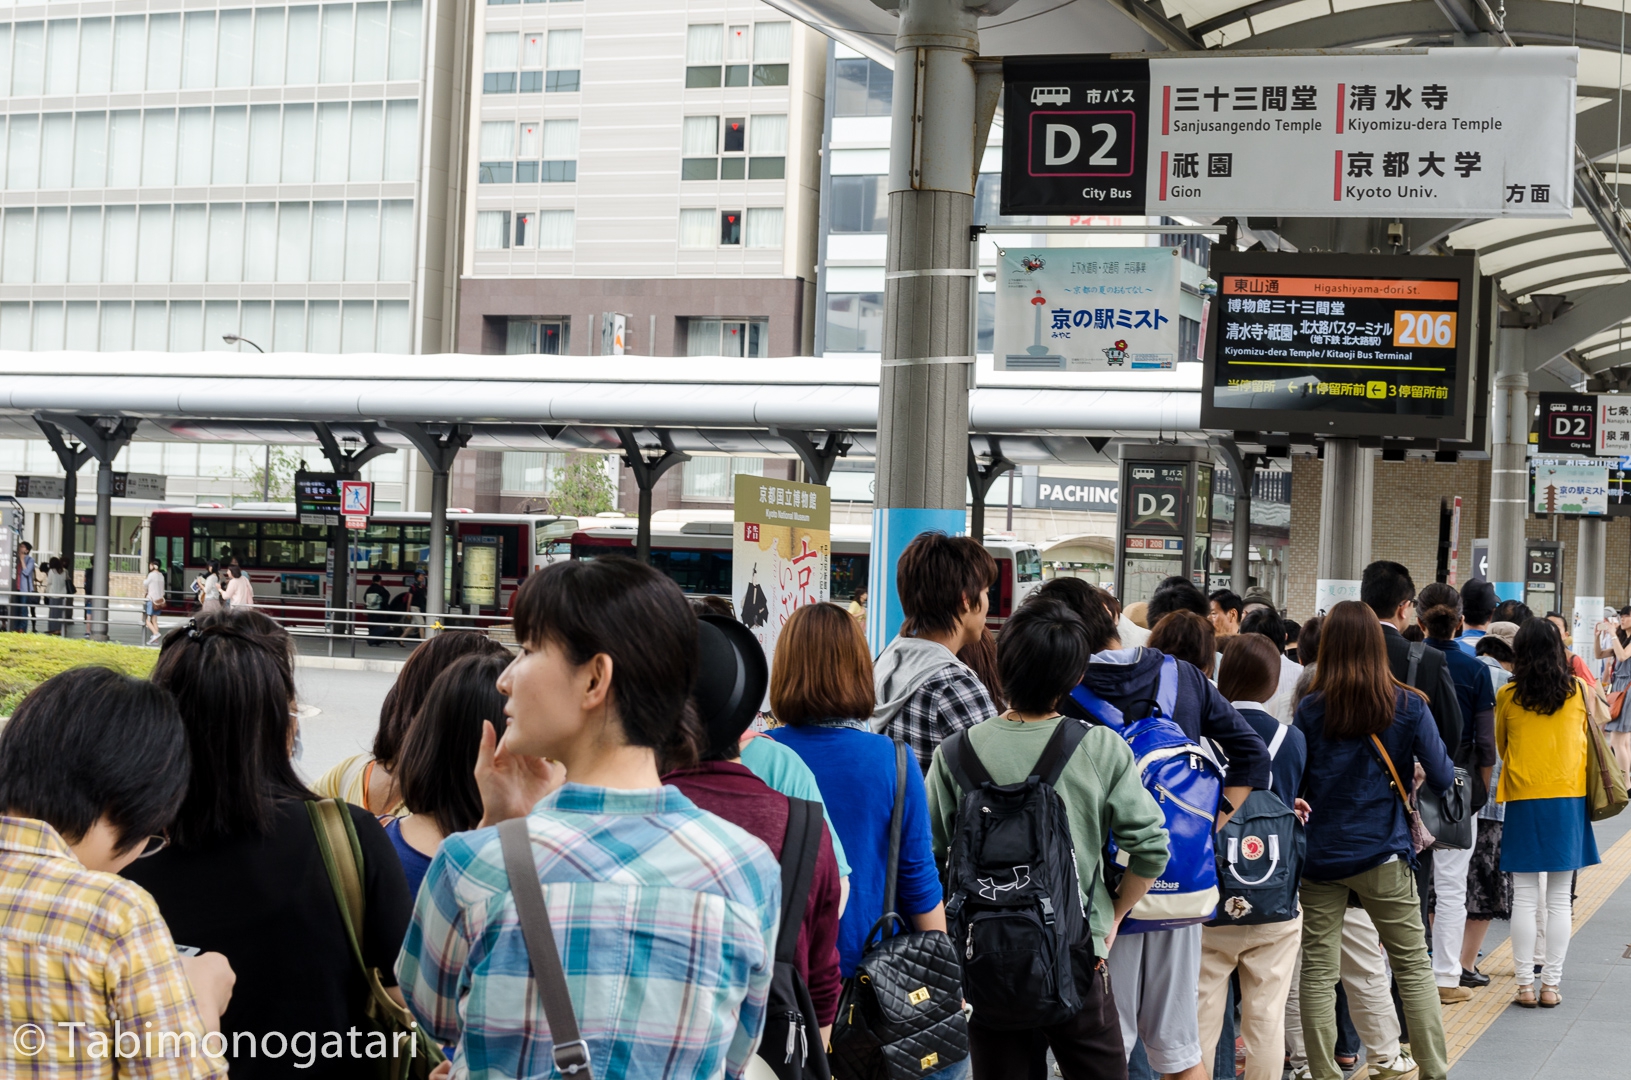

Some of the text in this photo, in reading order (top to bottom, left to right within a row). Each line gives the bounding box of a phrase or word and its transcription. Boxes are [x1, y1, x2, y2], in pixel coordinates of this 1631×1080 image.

[1086, 88, 1136, 104] 市バス
[1174, 85, 1318, 112] 三十三間堂
[1349, 83, 1449, 111] 清水寺
[1173, 118, 1322, 135] Sanjusangendo Temple
[1348, 117, 1502, 133] Kiyomizu-dera Temple
[1044, 123, 1118, 166] D2
[1172, 152, 1233, 178] 祇園
[1346, 151, 1482, 178] 京都大学
[1082, 187, 1132, 200] City Bus
[1171, 185, 1202, 198] Gion
[1346, 185, 1438, 201] Kyoto Univ.
[1506, 184, 1551, 203] 方面
[1233, 279, 1280, 294] 東山通
[1314, 283, 1420, 295] Higashiyama-dori St.
[1227, 298, 1345, 315] 博物館三十三間堂
[1051, 308, 1169, 330] 京の駅ミスト
[1051, 331, 1072, 339] みやこ
[1398, 312, 1452, 345] 206
[1225, 347, 1288, 357] Kiyomizu-dera
[1289, 348, 1320, 358] Temple
[1326, 350, 1356, 360] Kitaoji
[1357, 351, 1373, 360] Bus
[1375, 351, 1413, 361] Terminal
[1227, 379, 1276, 393] 当停留所
[1607, 405, 1631, 416] 七条
[1555, 417, 1586, 436] D2
[759, 485, 817, 510] 京都国立博物館
[1559, 485, 1606, 496] 京の駅ミスト
[1137, 493, 1176, 517] D2
[765, 508, 777, 519] Kyoto
[1532, 562, 1552, 574] D3
[1152, 880, 1180, 889] öbus
